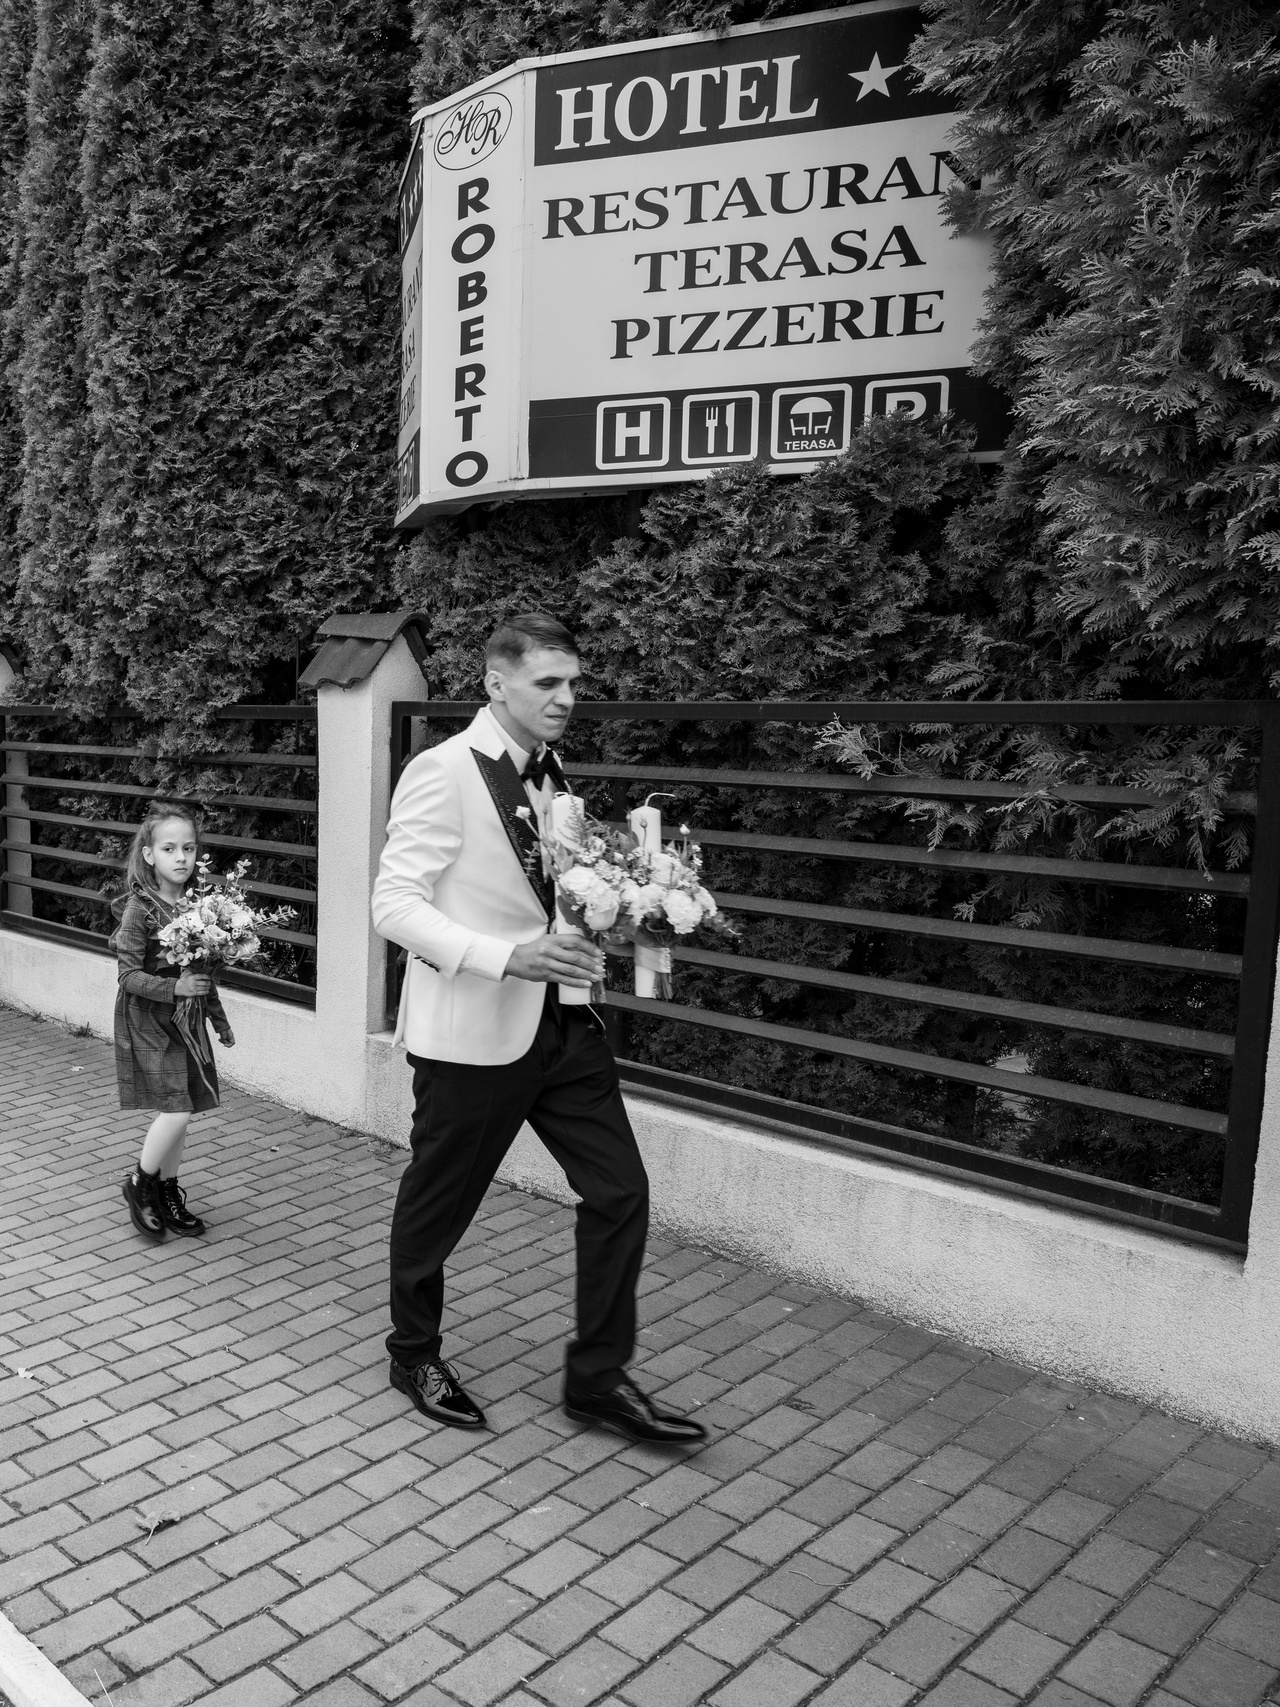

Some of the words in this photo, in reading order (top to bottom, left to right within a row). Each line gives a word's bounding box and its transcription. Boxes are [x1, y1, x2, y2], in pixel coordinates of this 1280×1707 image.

[554, 54, 819, 151] HOTEL
[634, 224, 926, 294] TERASA
[445, 176, 496, 488] ROBERTO
[609, 289, 946, 360] PIZZERIE
[784, 438, 837, 451] TERASA
